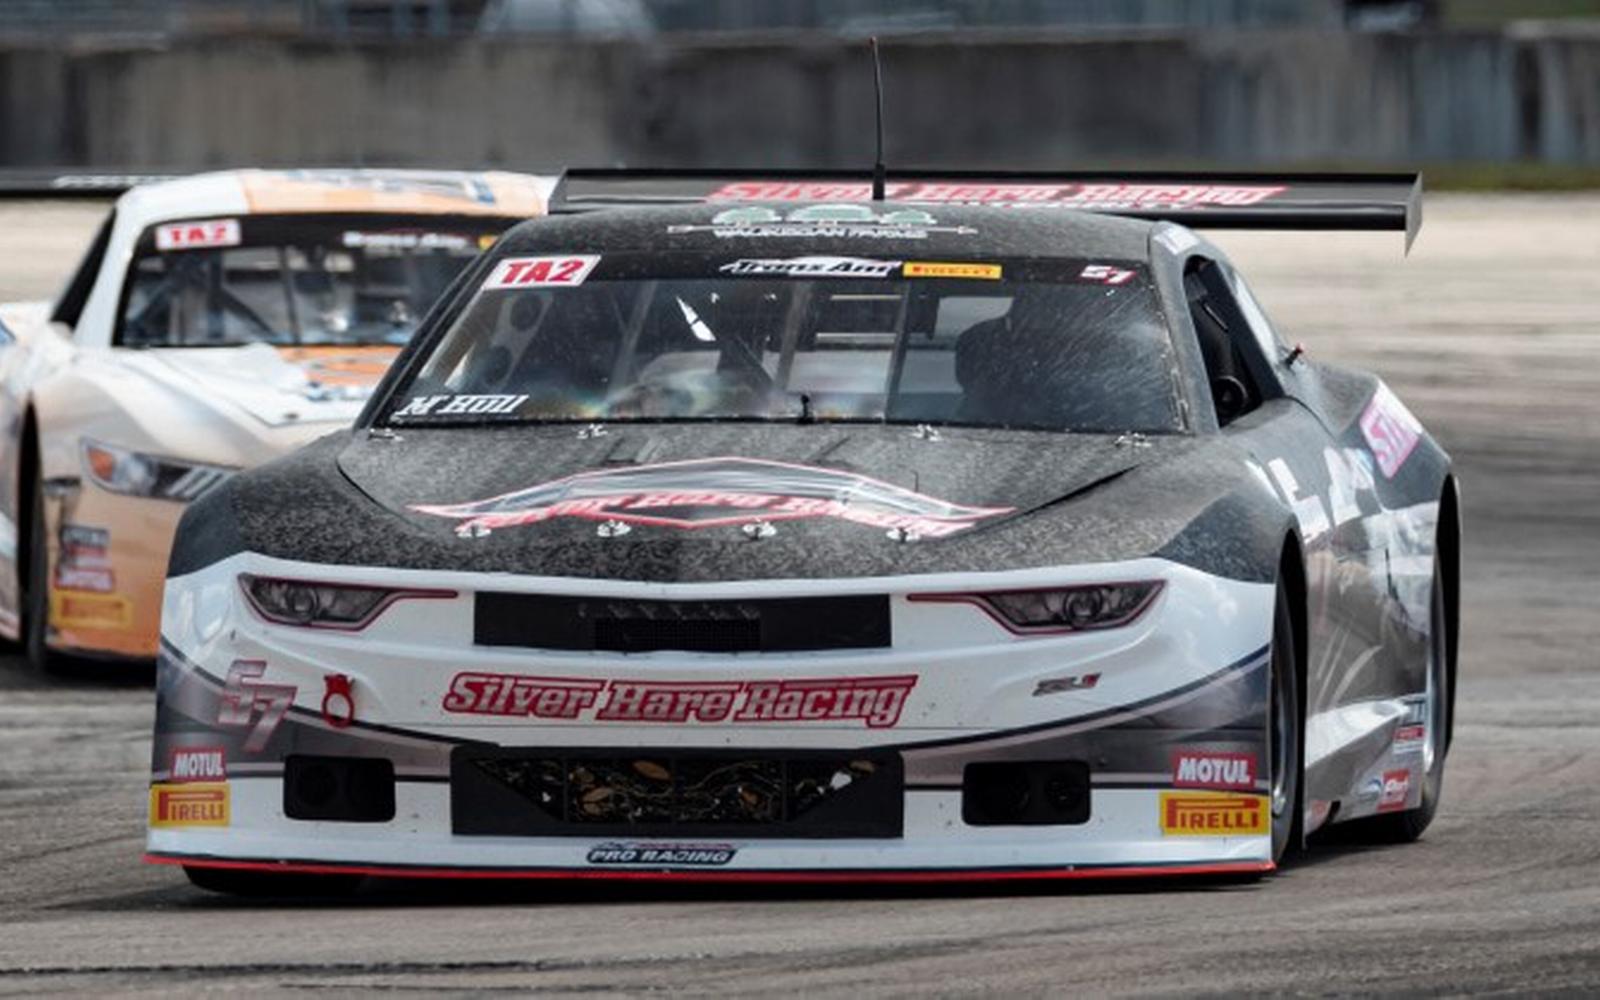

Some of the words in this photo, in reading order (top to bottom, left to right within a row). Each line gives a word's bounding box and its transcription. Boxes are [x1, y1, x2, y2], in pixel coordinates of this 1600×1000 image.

[502, 259, 585, 284] TA2
[443, 672, 603, 719] Silver
[595, 680, 742, 723] Hare
[733, 674, 918, 729] Racing
[172, 752, 225, 776] MOTUL
[1176, 757, 1252, 784] MOTUL
[157, 791, 226, 821] PIRELLI
[1165, 797, 1261, 829] PIRELLI
[590, 850, 637, 862] PRO
[641, 850, 731, 863] RACING
